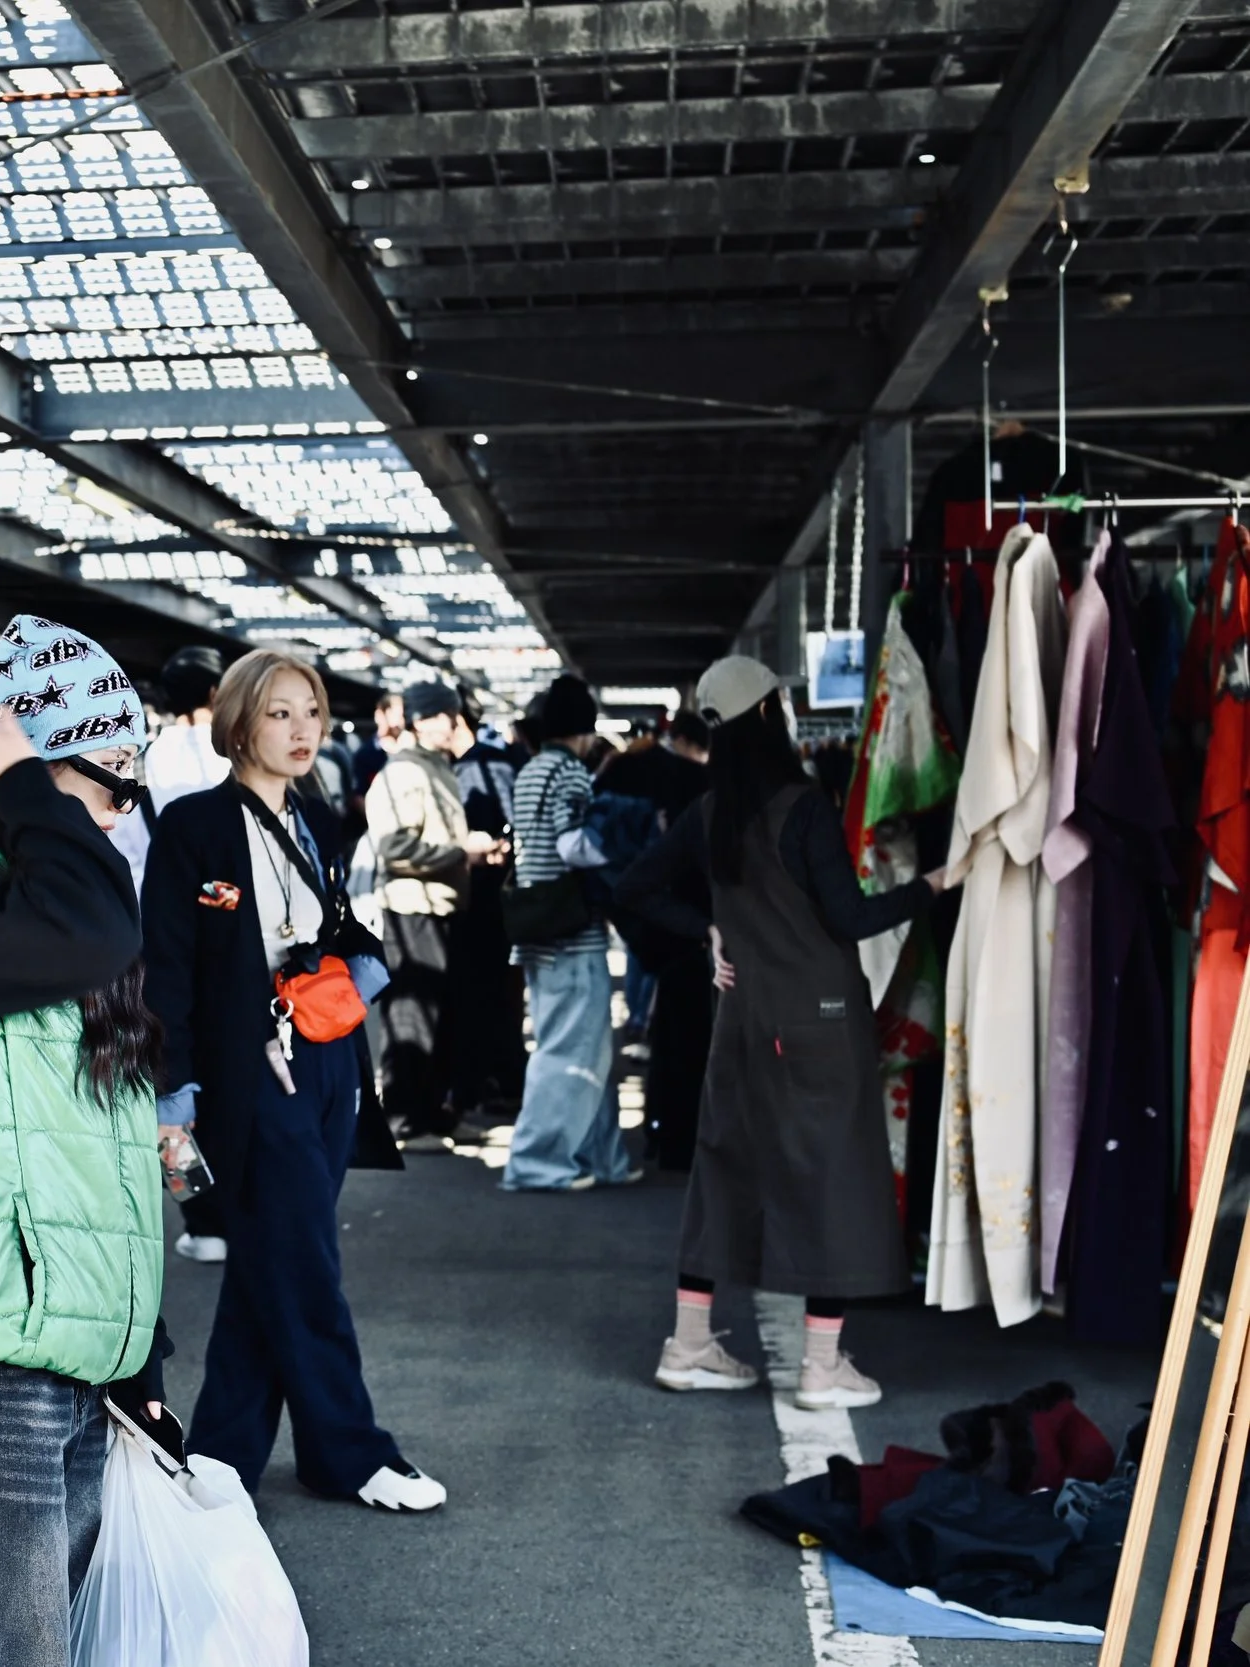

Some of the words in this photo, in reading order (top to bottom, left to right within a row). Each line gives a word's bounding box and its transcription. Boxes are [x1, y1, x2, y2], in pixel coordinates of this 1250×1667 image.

[33, 638, 78, 669] afb
[90, 671, 131, 696] afb
[48, 716, 112, 749] afb
